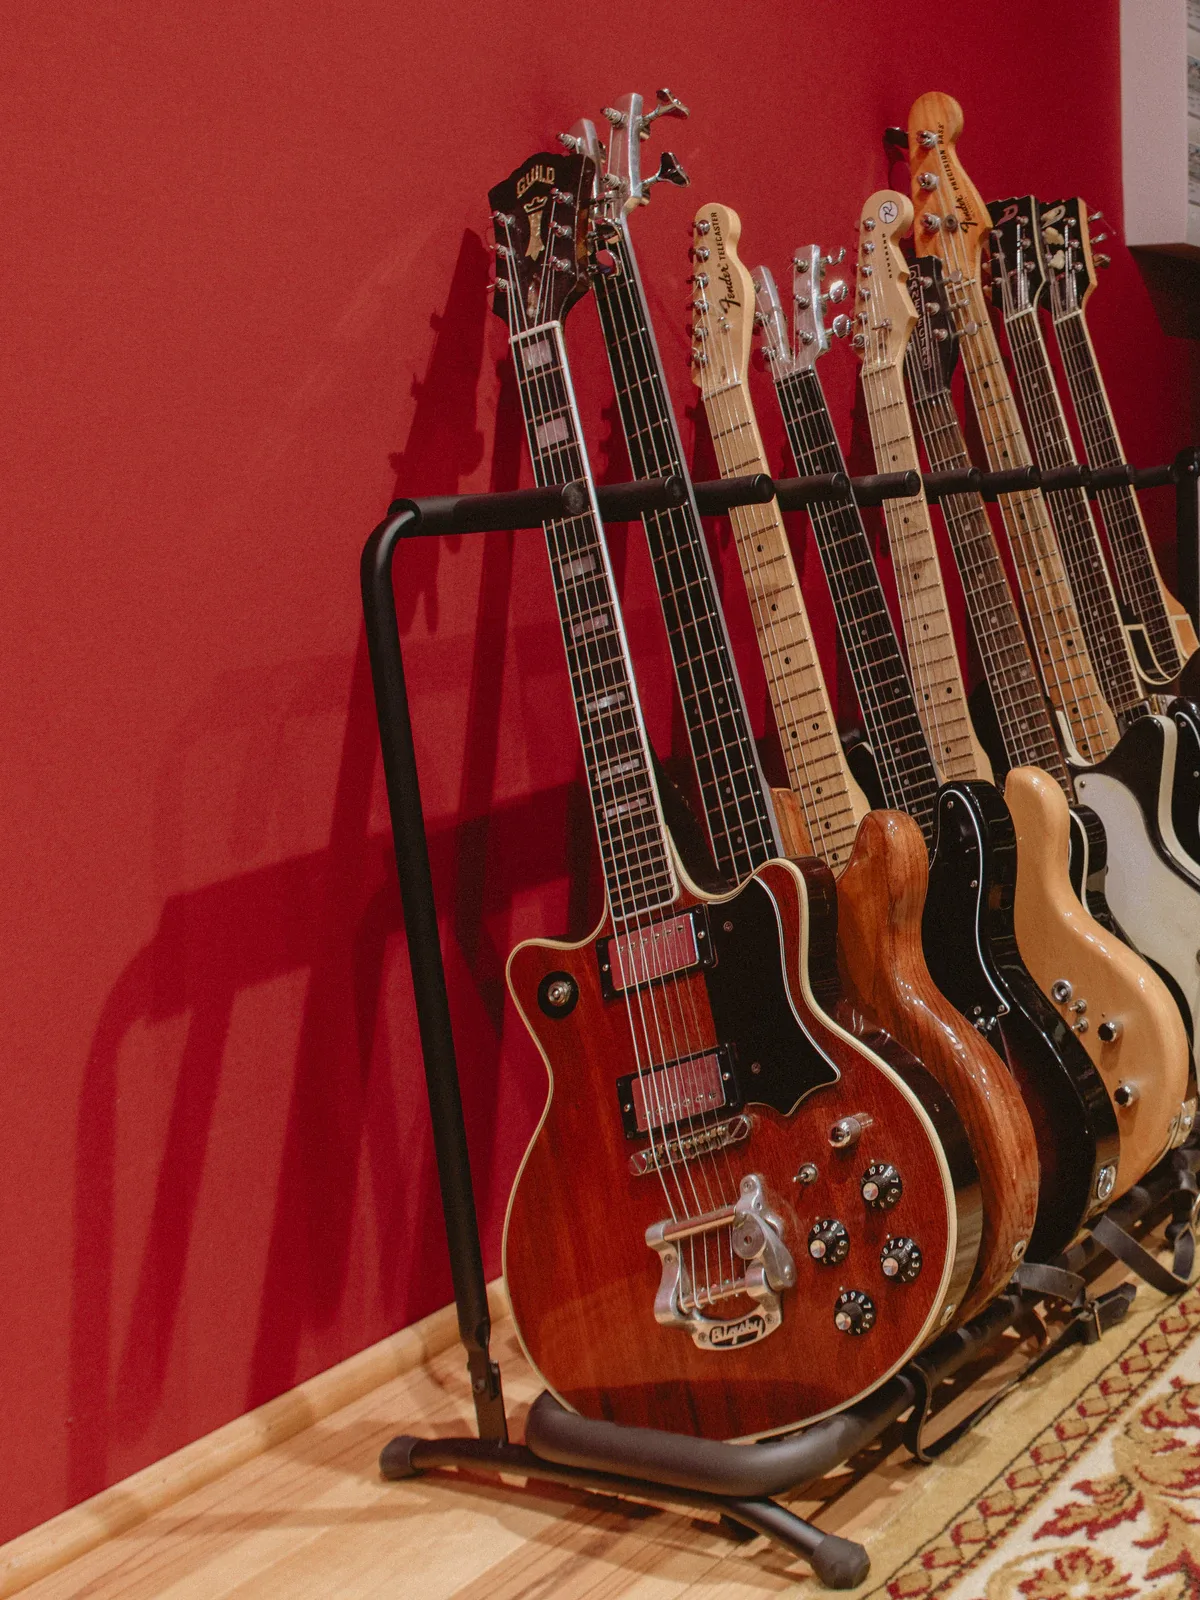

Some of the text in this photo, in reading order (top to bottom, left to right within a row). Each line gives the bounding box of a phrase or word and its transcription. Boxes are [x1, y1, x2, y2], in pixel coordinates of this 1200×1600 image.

[516, 164, 556, 199] GUILD
[939, 149, 960, 192] PRECISION
[956, 194, 979, 234] Fender
[710, 211, 742, 314] Fender TELECASTER
[908, 269, 930, 367] DANEECTRO
[711, 1318, 764, 1346] Bigsby
